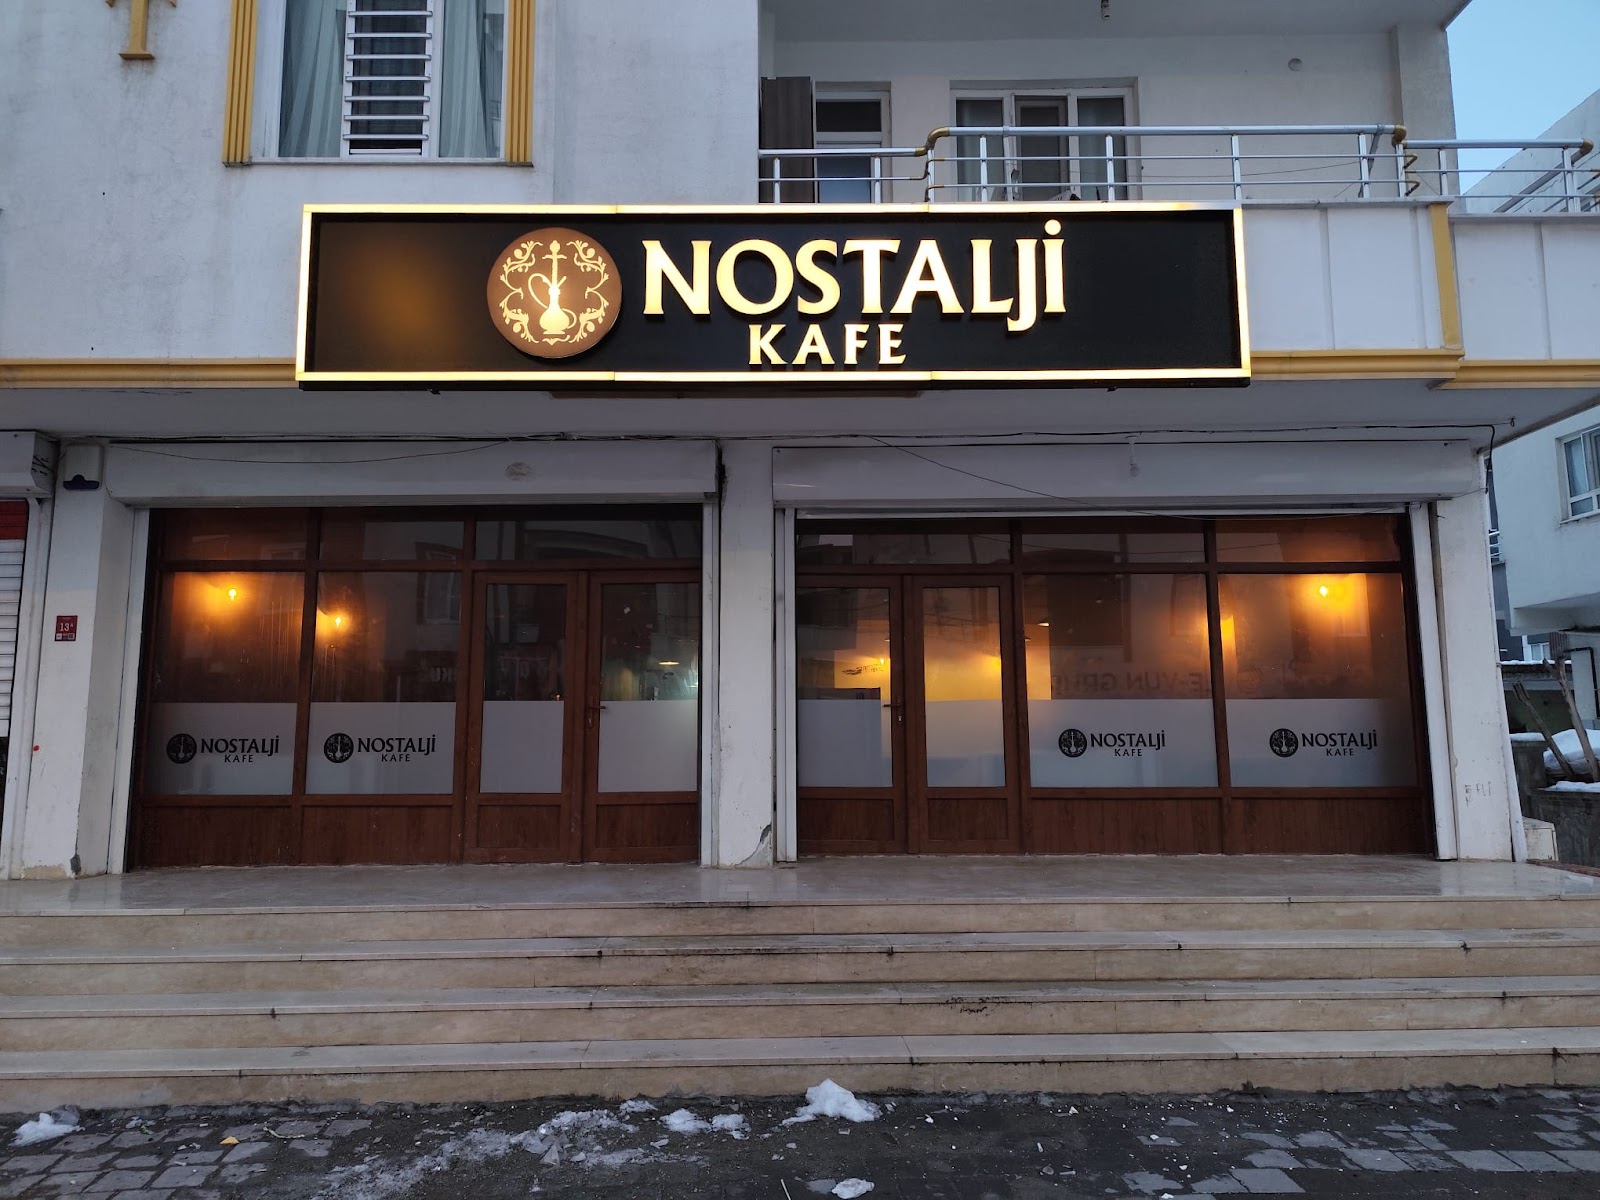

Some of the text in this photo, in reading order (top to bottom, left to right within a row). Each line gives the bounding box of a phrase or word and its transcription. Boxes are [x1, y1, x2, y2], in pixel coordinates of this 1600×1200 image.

[748, 323, 907, 365] KAFE
[1114, 748, 1143, 757] KAFE
[1326, 748, 1355, 757] KAFE
[224, 754, 254, 763] KAFE
[381, 753, 411, 762] KAFE
